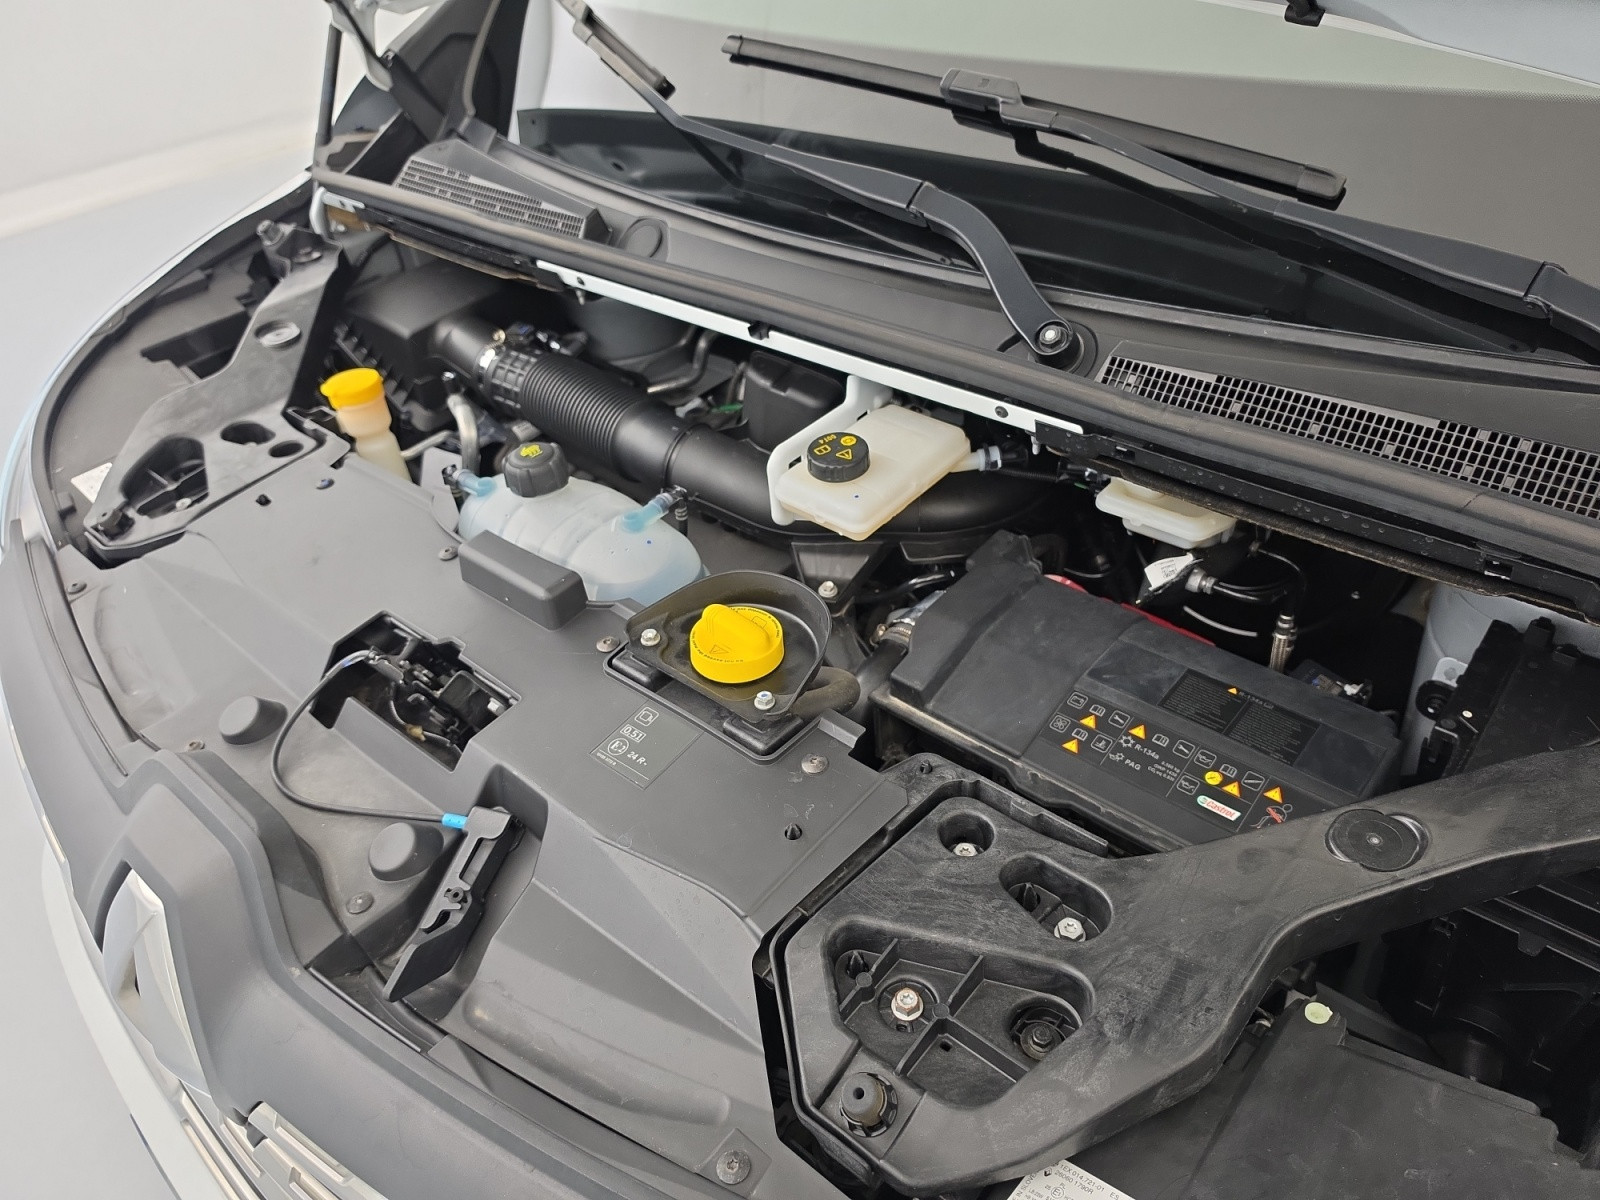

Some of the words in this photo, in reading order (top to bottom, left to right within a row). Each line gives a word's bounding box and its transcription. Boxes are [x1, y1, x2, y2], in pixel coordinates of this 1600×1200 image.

[627, 751, 639, 760] 24
[1134, 743, 1160, 760] R-134a
[1206, 801, 1236, 818] Castrol
